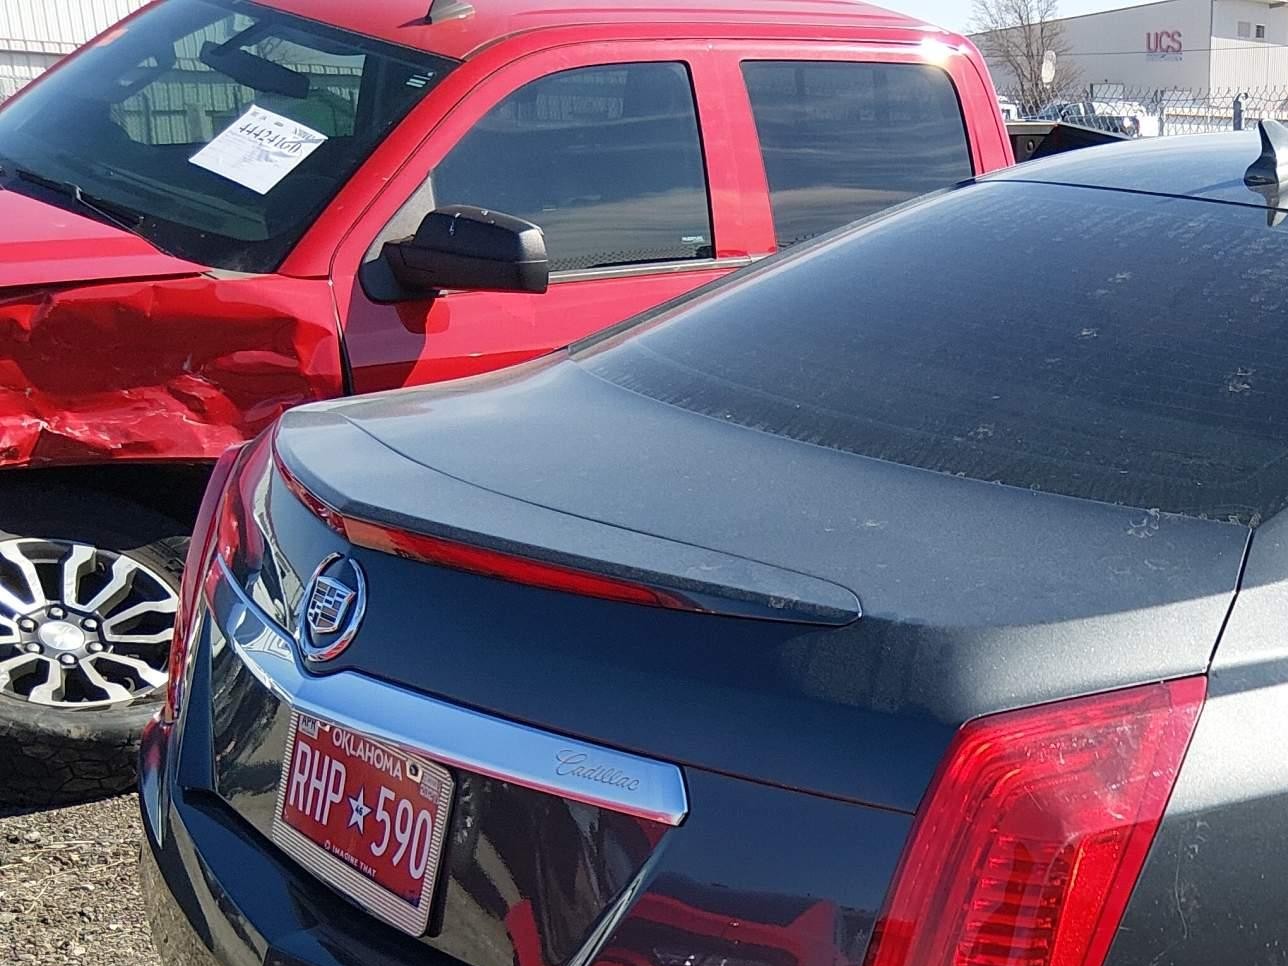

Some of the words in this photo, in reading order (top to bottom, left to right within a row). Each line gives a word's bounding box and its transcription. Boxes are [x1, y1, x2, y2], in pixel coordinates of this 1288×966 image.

[1146, 31, 1182, 53] UCS
[332, 728, 402, 781] OKLAHOMA
[555, 750, 640, 791] Cadillac
[289, 741, 347, 826] RHP
[370, 786, 433, 880] 590
[332, 845, 359, 867] IMAGINE
[360, 861, 377, 878] THAT
